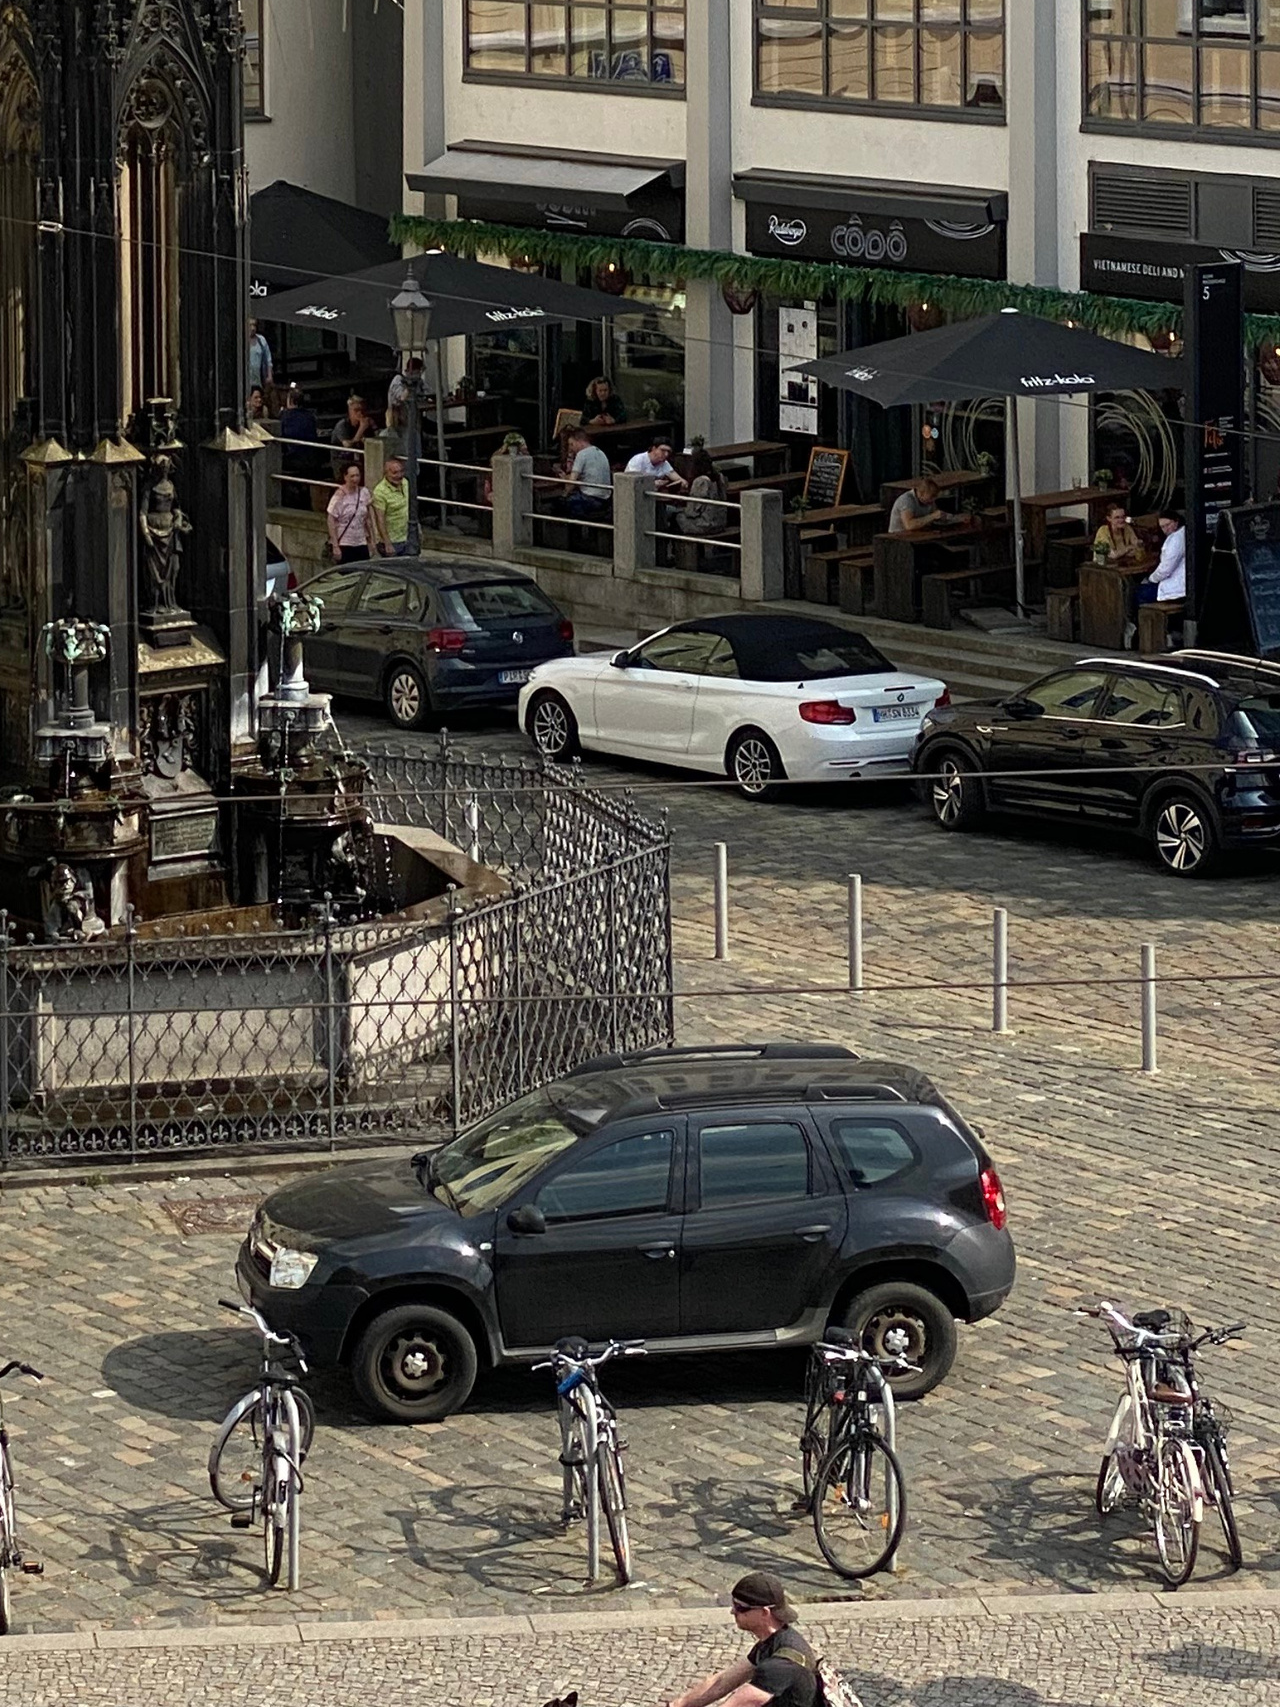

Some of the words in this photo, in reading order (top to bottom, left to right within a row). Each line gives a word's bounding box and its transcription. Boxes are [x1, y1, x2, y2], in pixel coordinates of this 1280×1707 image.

[1093, 259, 1142, 274] VIETNAMESE
[1142, 264, 1160, 276] DELI
[1161, 266, 1178, 279] AND
[1202, 286, 1210, 300] 5
[1020, 374, 1095, 388] fritz-kola
